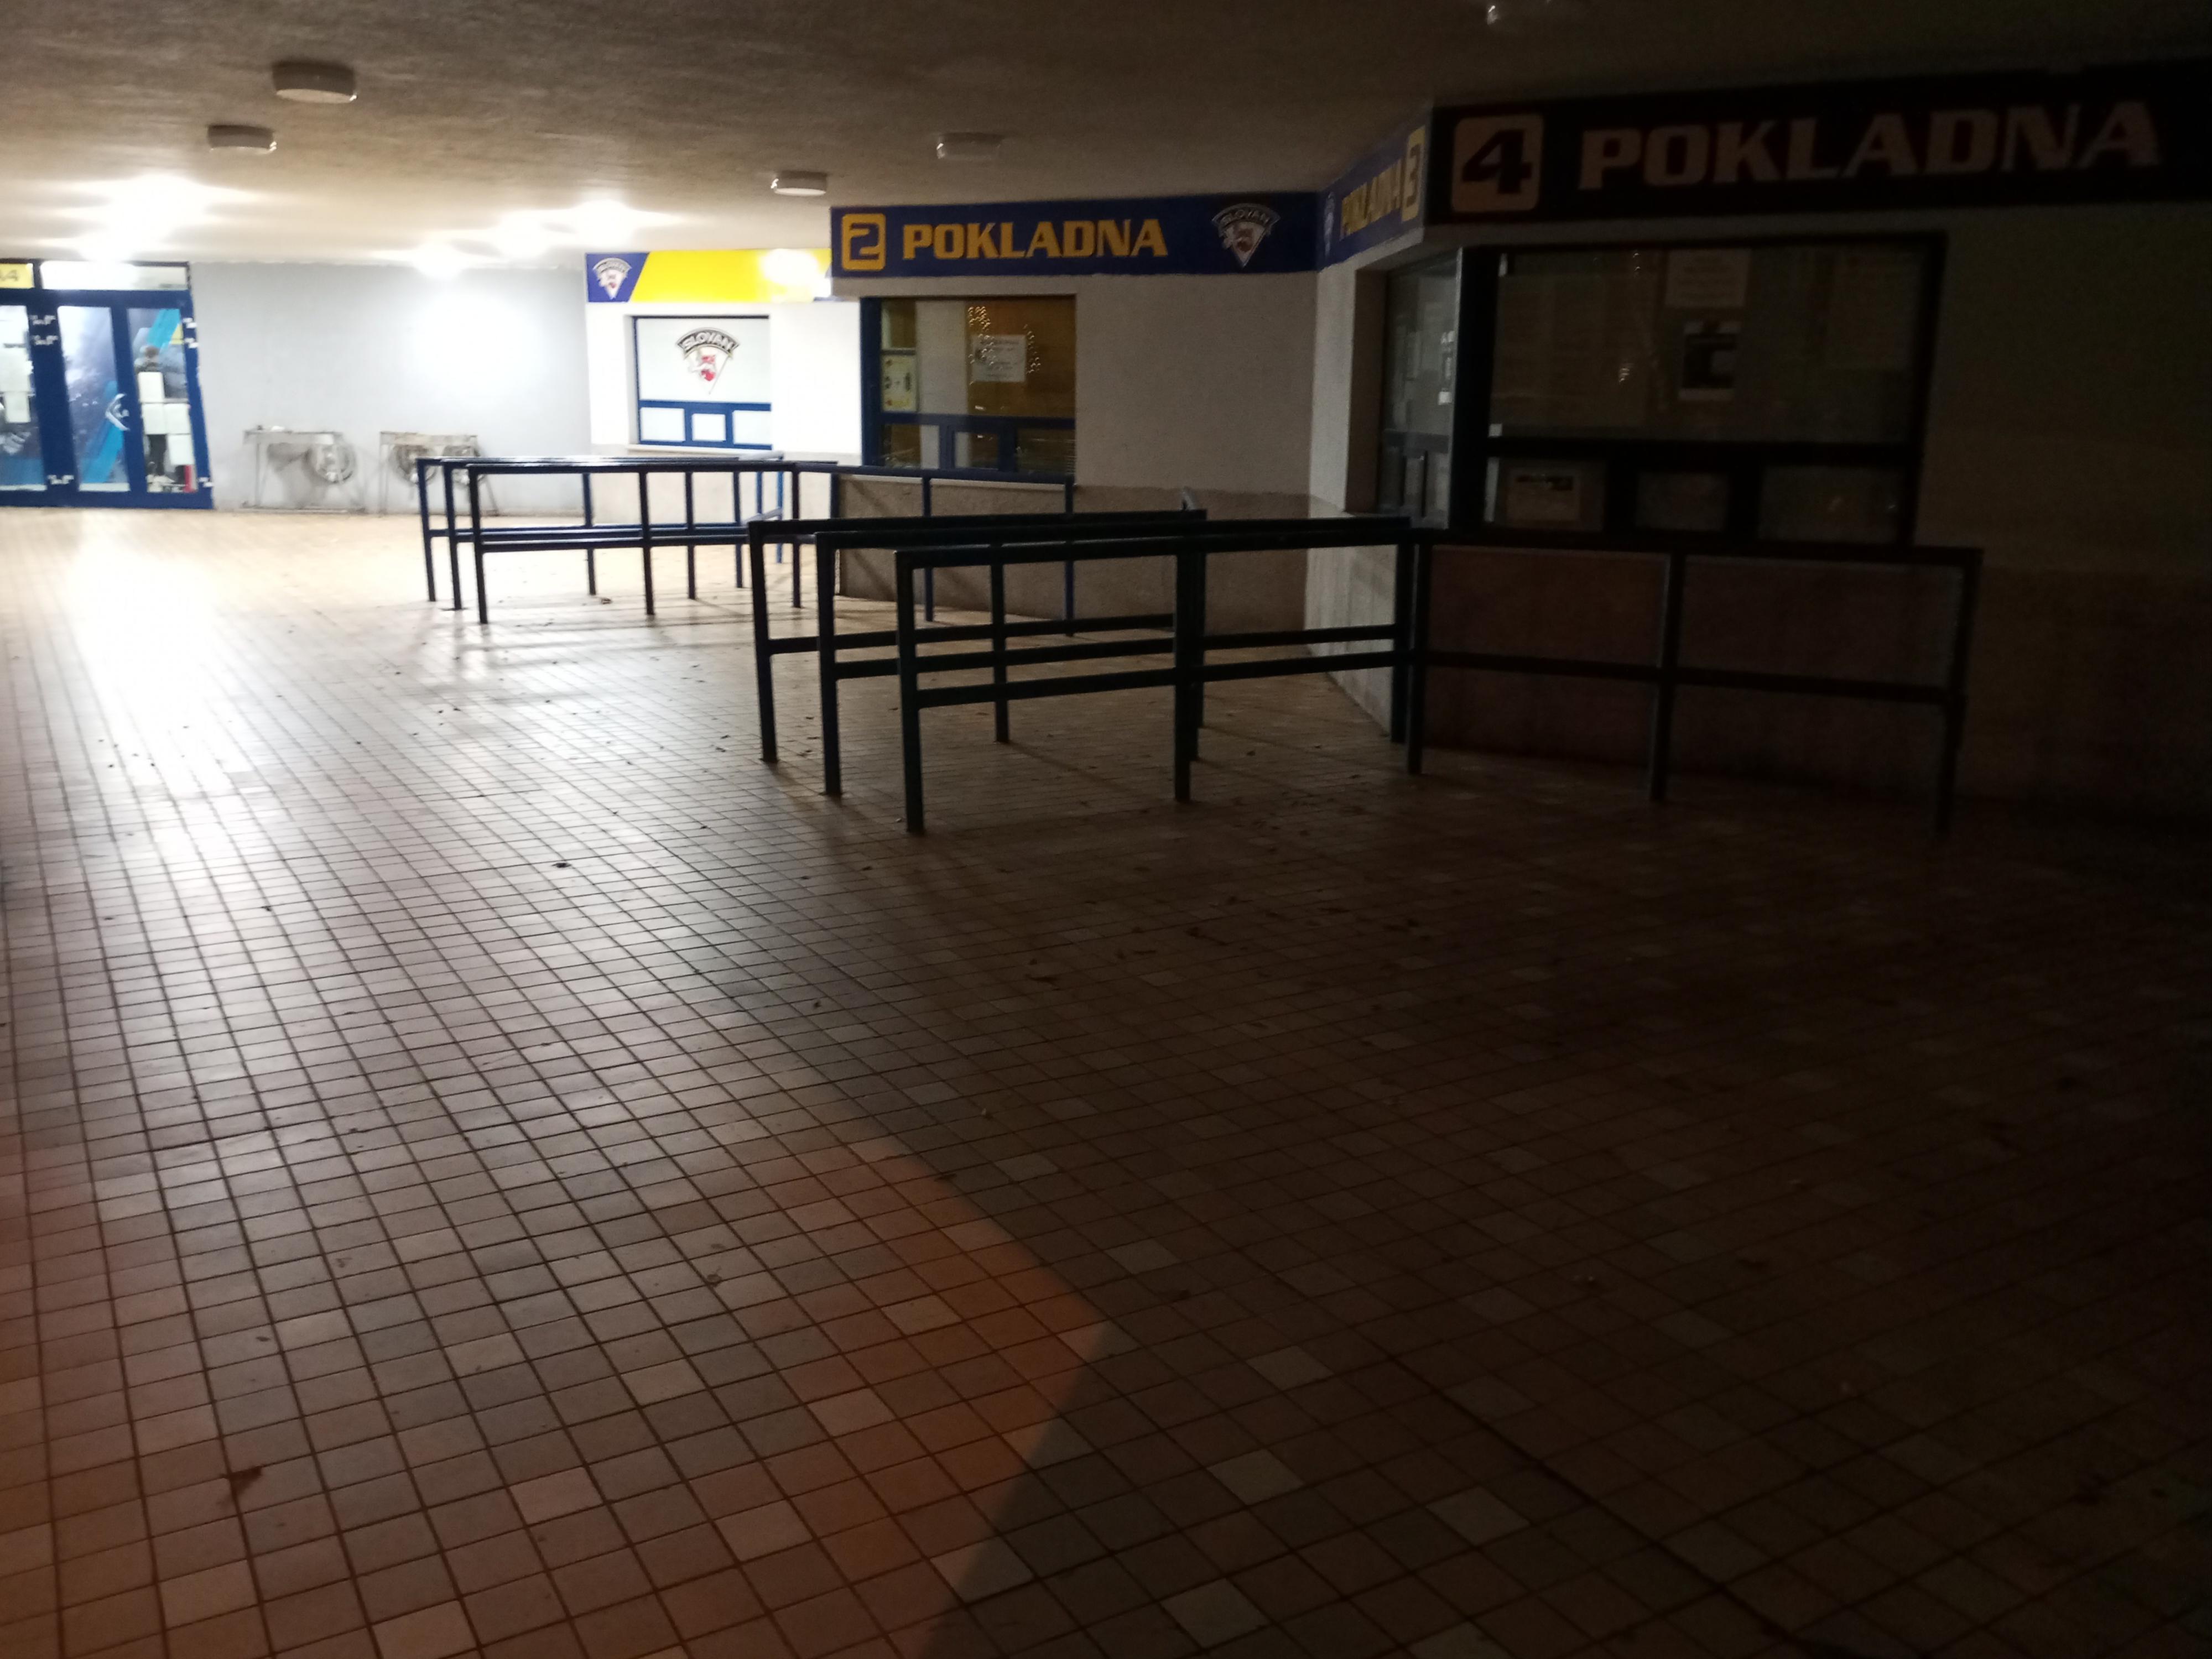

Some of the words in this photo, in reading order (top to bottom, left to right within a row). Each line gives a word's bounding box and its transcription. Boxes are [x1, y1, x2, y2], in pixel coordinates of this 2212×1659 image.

[1461, 128, 1533, 195] 4
[1576, 100, 2165, 191] POKLADNA
[1406, 143, 1422, 208] 3
[848, 221, 881, 261] 2
[902, 219, 1168, 260] POKLADNA
[681, 331, 736, 352] SLOVAN
